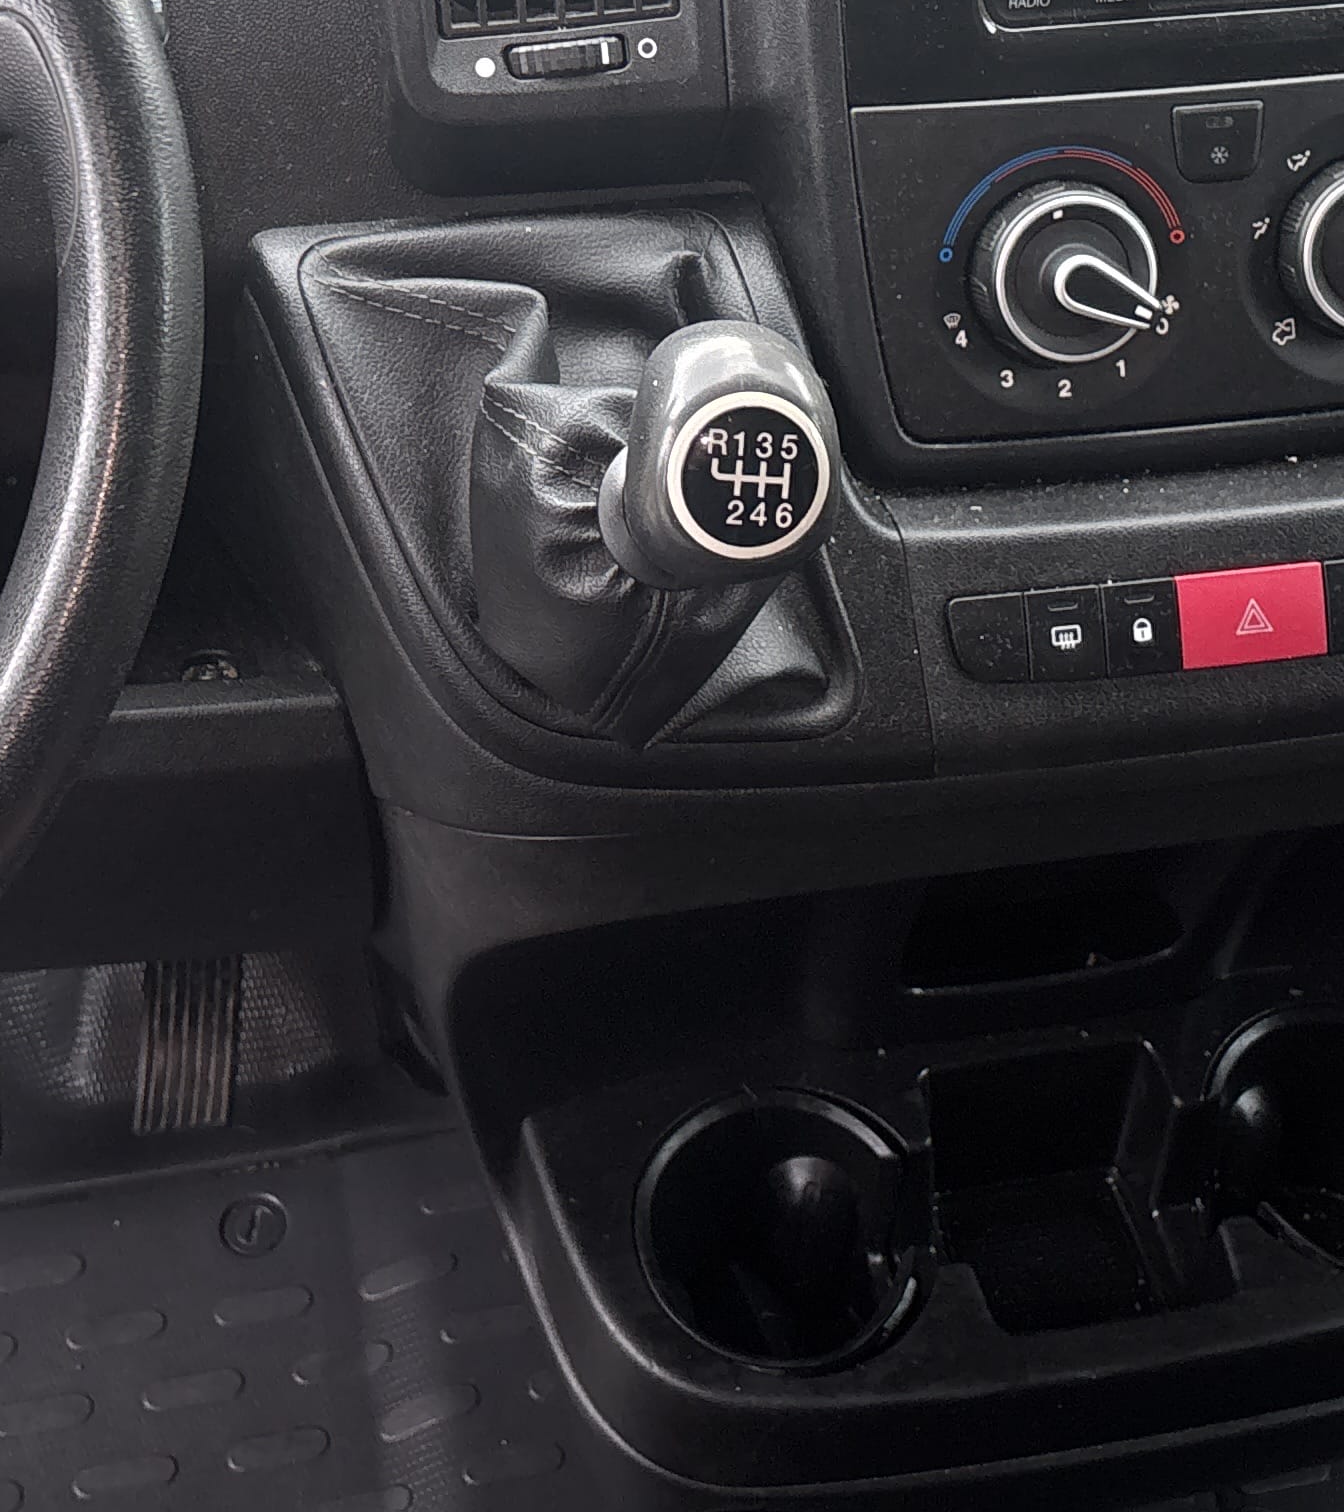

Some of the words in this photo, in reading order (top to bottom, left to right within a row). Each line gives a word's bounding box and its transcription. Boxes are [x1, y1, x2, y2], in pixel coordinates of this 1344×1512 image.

[955, 329, 969, 349] 4
[999, 369, 1015, 388] 3
[1116, 359, 1128, 379] 1
[1058, 379, 1073, 398] 2
